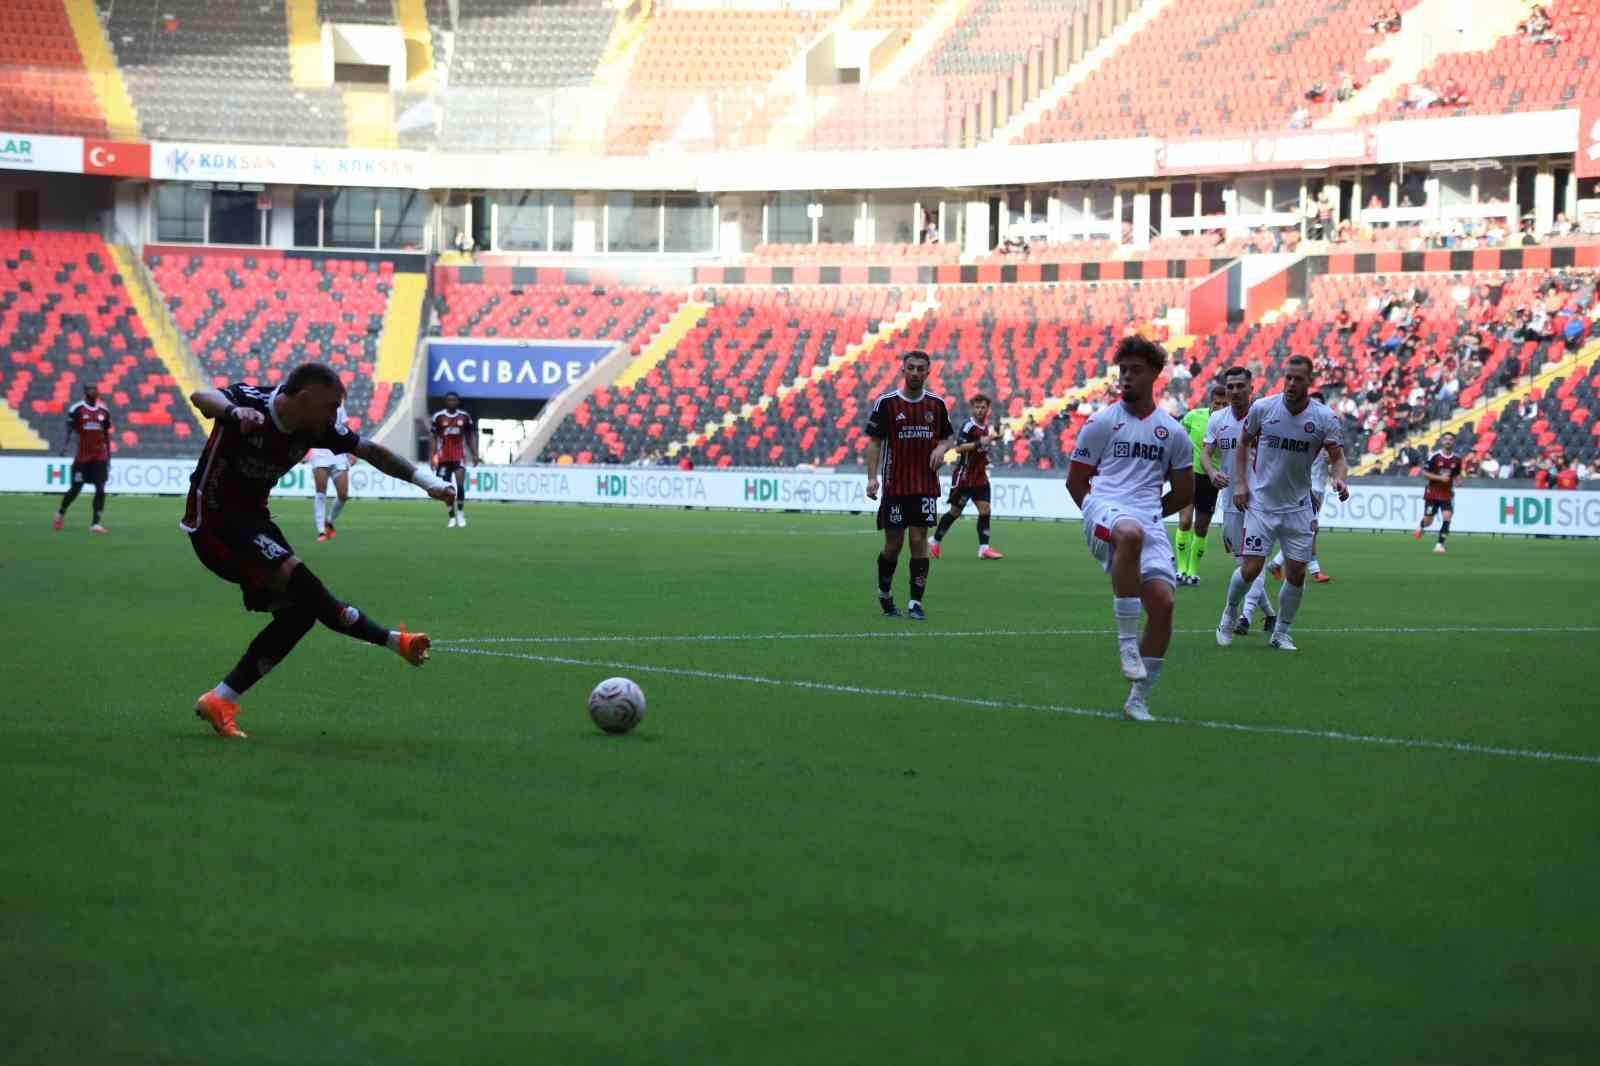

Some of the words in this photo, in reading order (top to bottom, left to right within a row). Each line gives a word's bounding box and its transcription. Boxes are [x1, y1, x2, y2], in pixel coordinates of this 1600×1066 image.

[0, 138, 33, 153] AR
[279, 469, 305, 489] DI
[464, 471, 498, 492] HDI
[596, 475, 627, 497] HDI
[744, 479, 778, 501] HDI
[921, 496, 936, 514] 28
[1499, 496, 1552, 526] HDI
